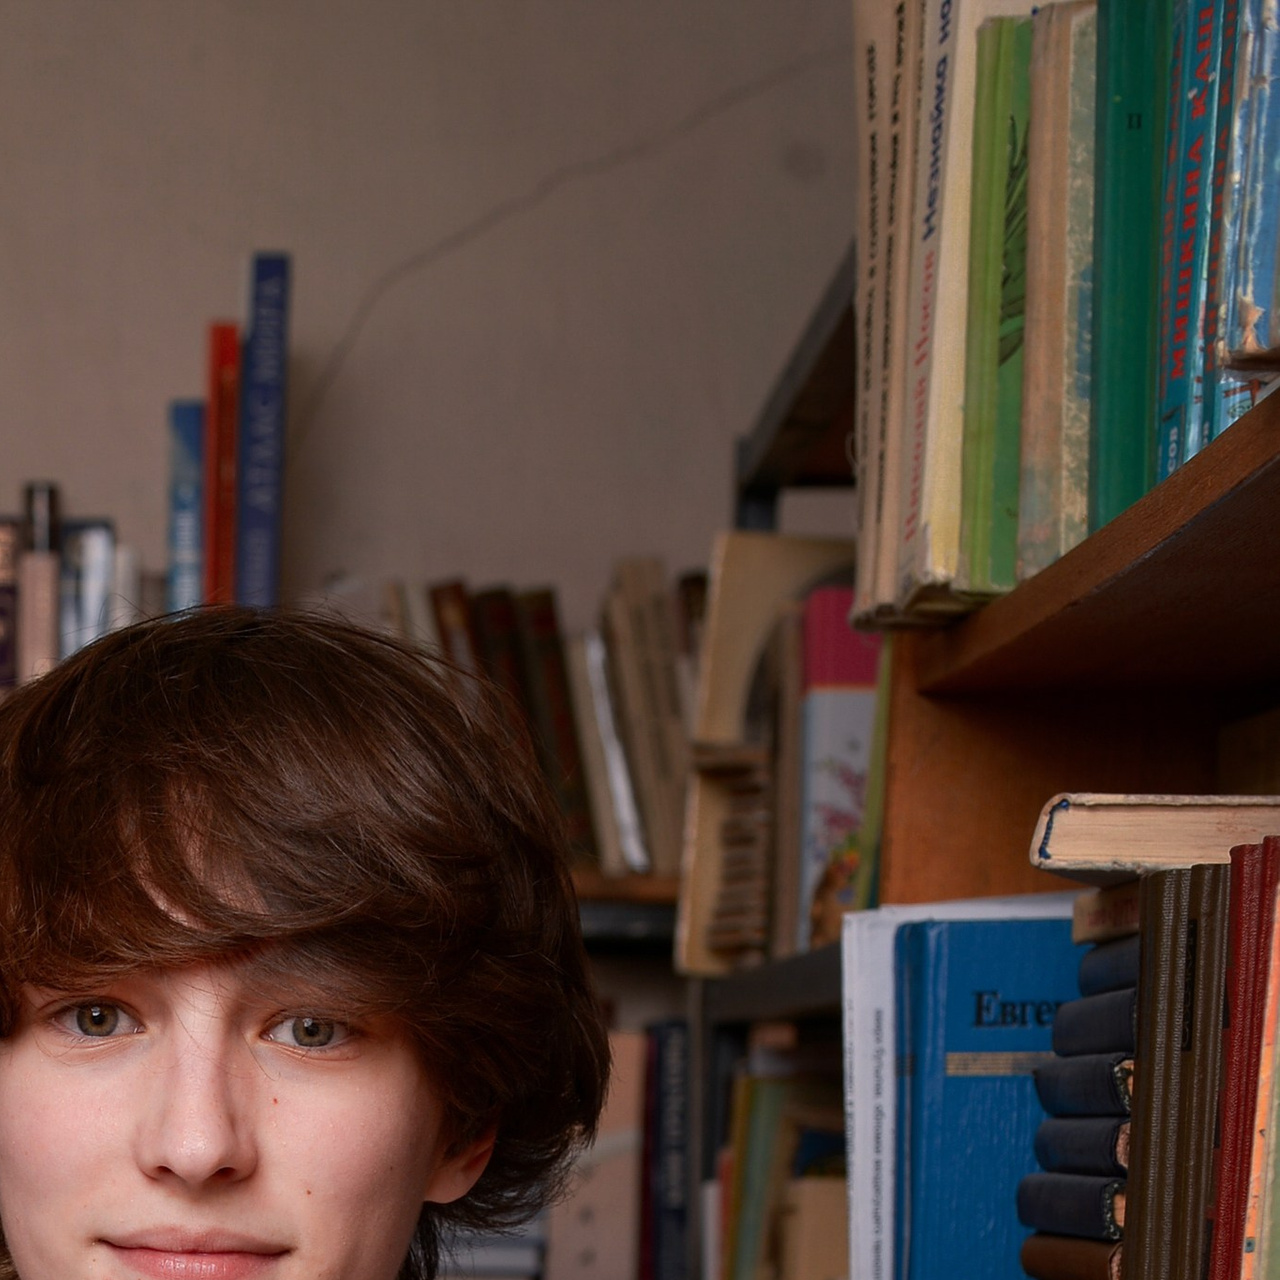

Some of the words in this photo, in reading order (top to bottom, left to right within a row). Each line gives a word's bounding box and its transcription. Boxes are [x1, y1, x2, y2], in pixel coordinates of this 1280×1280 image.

[1220, 0, 1238, 107] КАШ
[922, 56, 949, 241] Незнайка
[1171, 134, 1205, 380] МИШКИНА
[1191, 0, 1214, 121] КАШ
